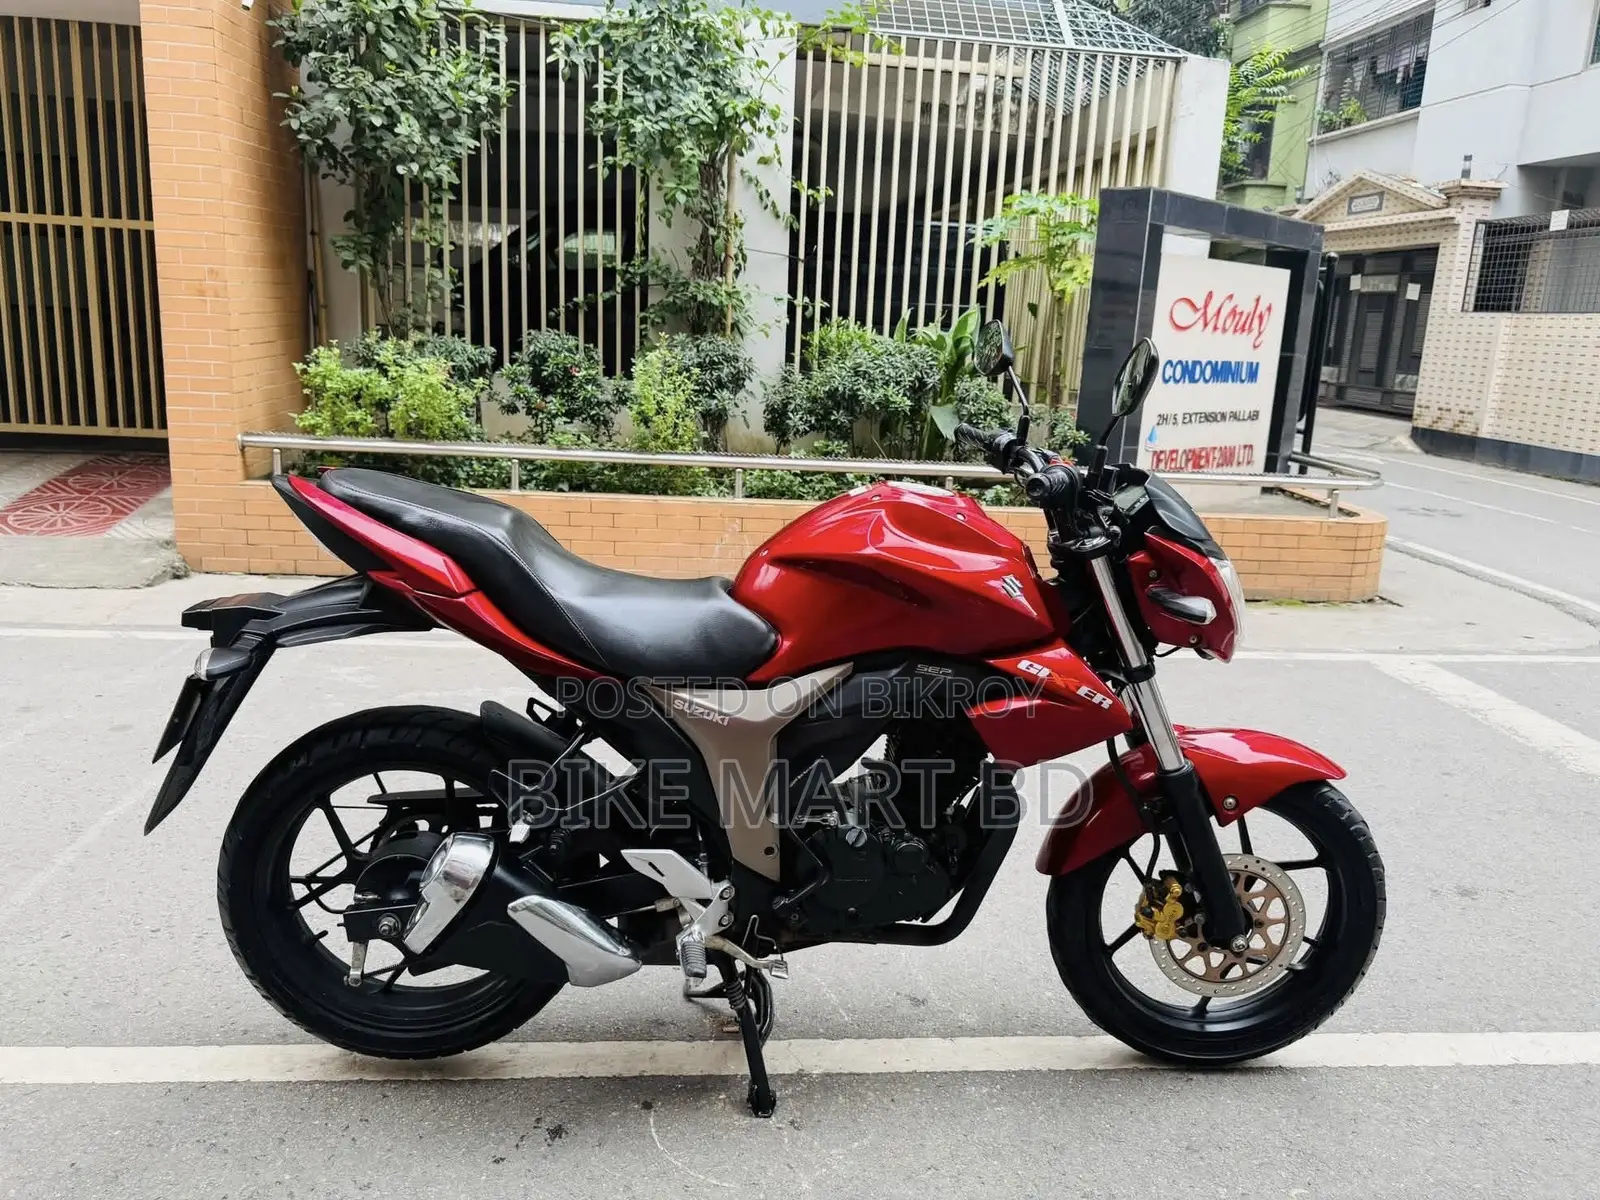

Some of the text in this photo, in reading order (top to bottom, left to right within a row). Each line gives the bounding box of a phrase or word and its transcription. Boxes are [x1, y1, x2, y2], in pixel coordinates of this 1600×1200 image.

[1169, 290, 1272, 349] Mouly
[1162, 359, 1260, 385] CONDOMINIUM
[1181, 411, 1228, 424] EXTENSION
[1229, 409, 1260, 421] PALLABI
[673, 699, 730, 726] SUZUKI
